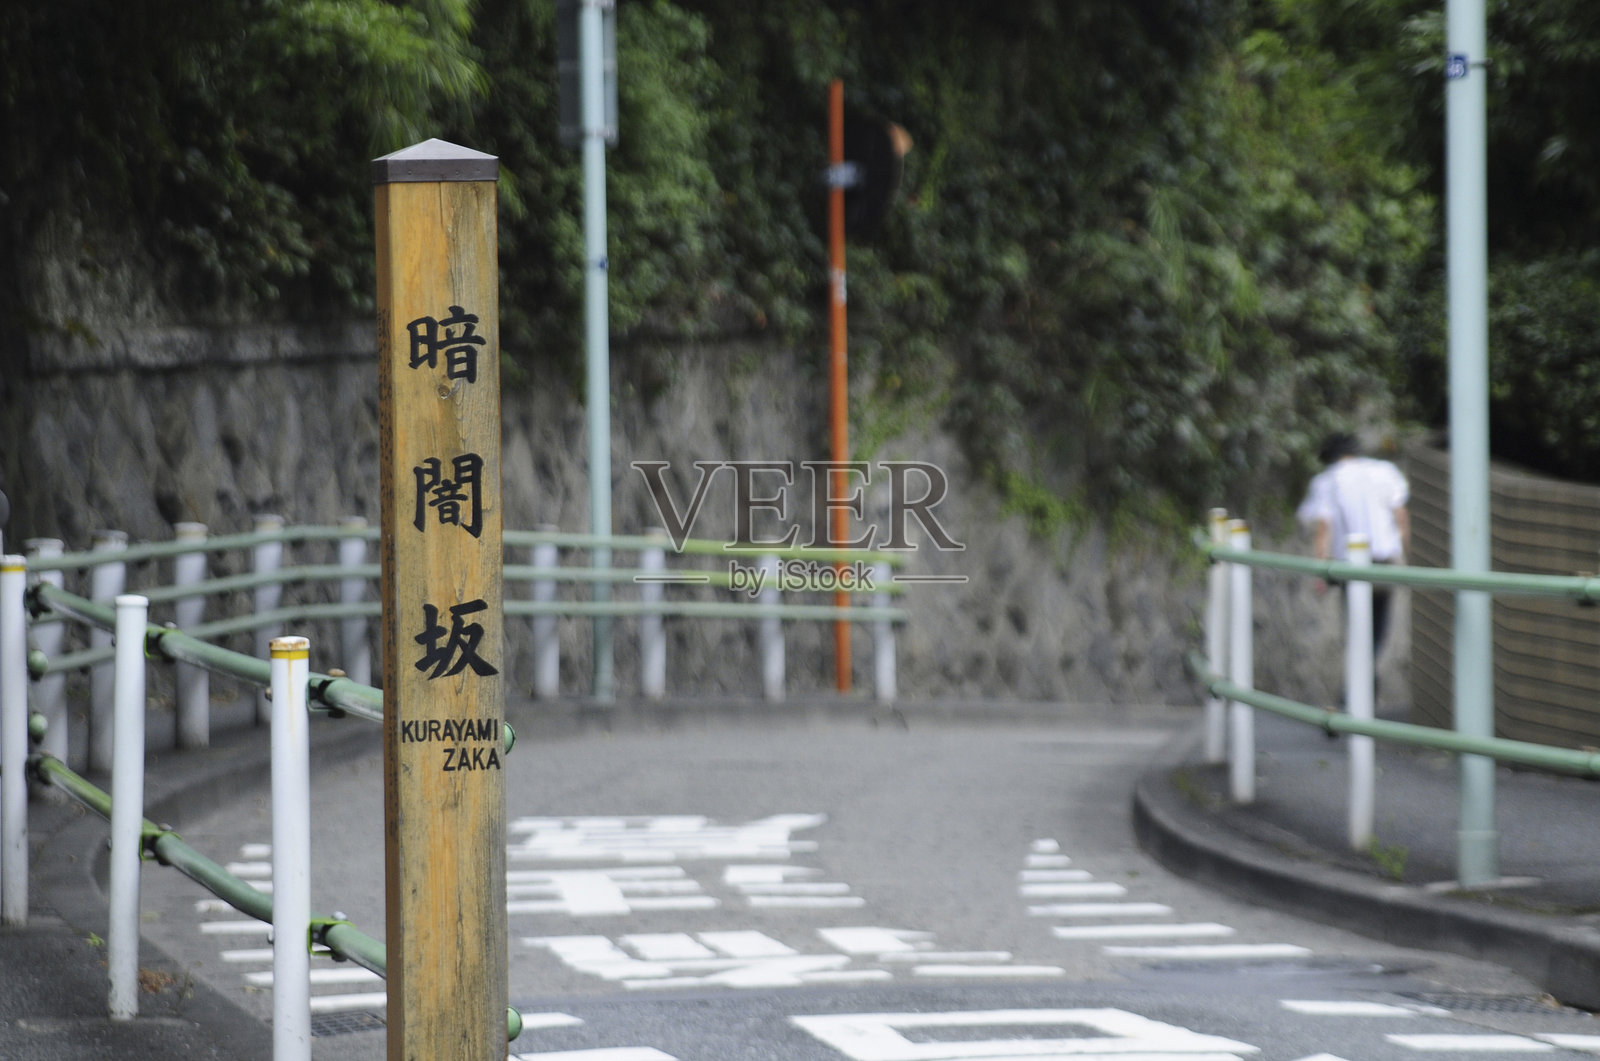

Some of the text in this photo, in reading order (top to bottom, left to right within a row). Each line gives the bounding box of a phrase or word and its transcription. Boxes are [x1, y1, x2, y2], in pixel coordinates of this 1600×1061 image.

[406, 305, 499, 681] 暗闇坂
[402, 718, 498, 743] KURAYAMI
[443, 747, 500, 771] ZAKA
